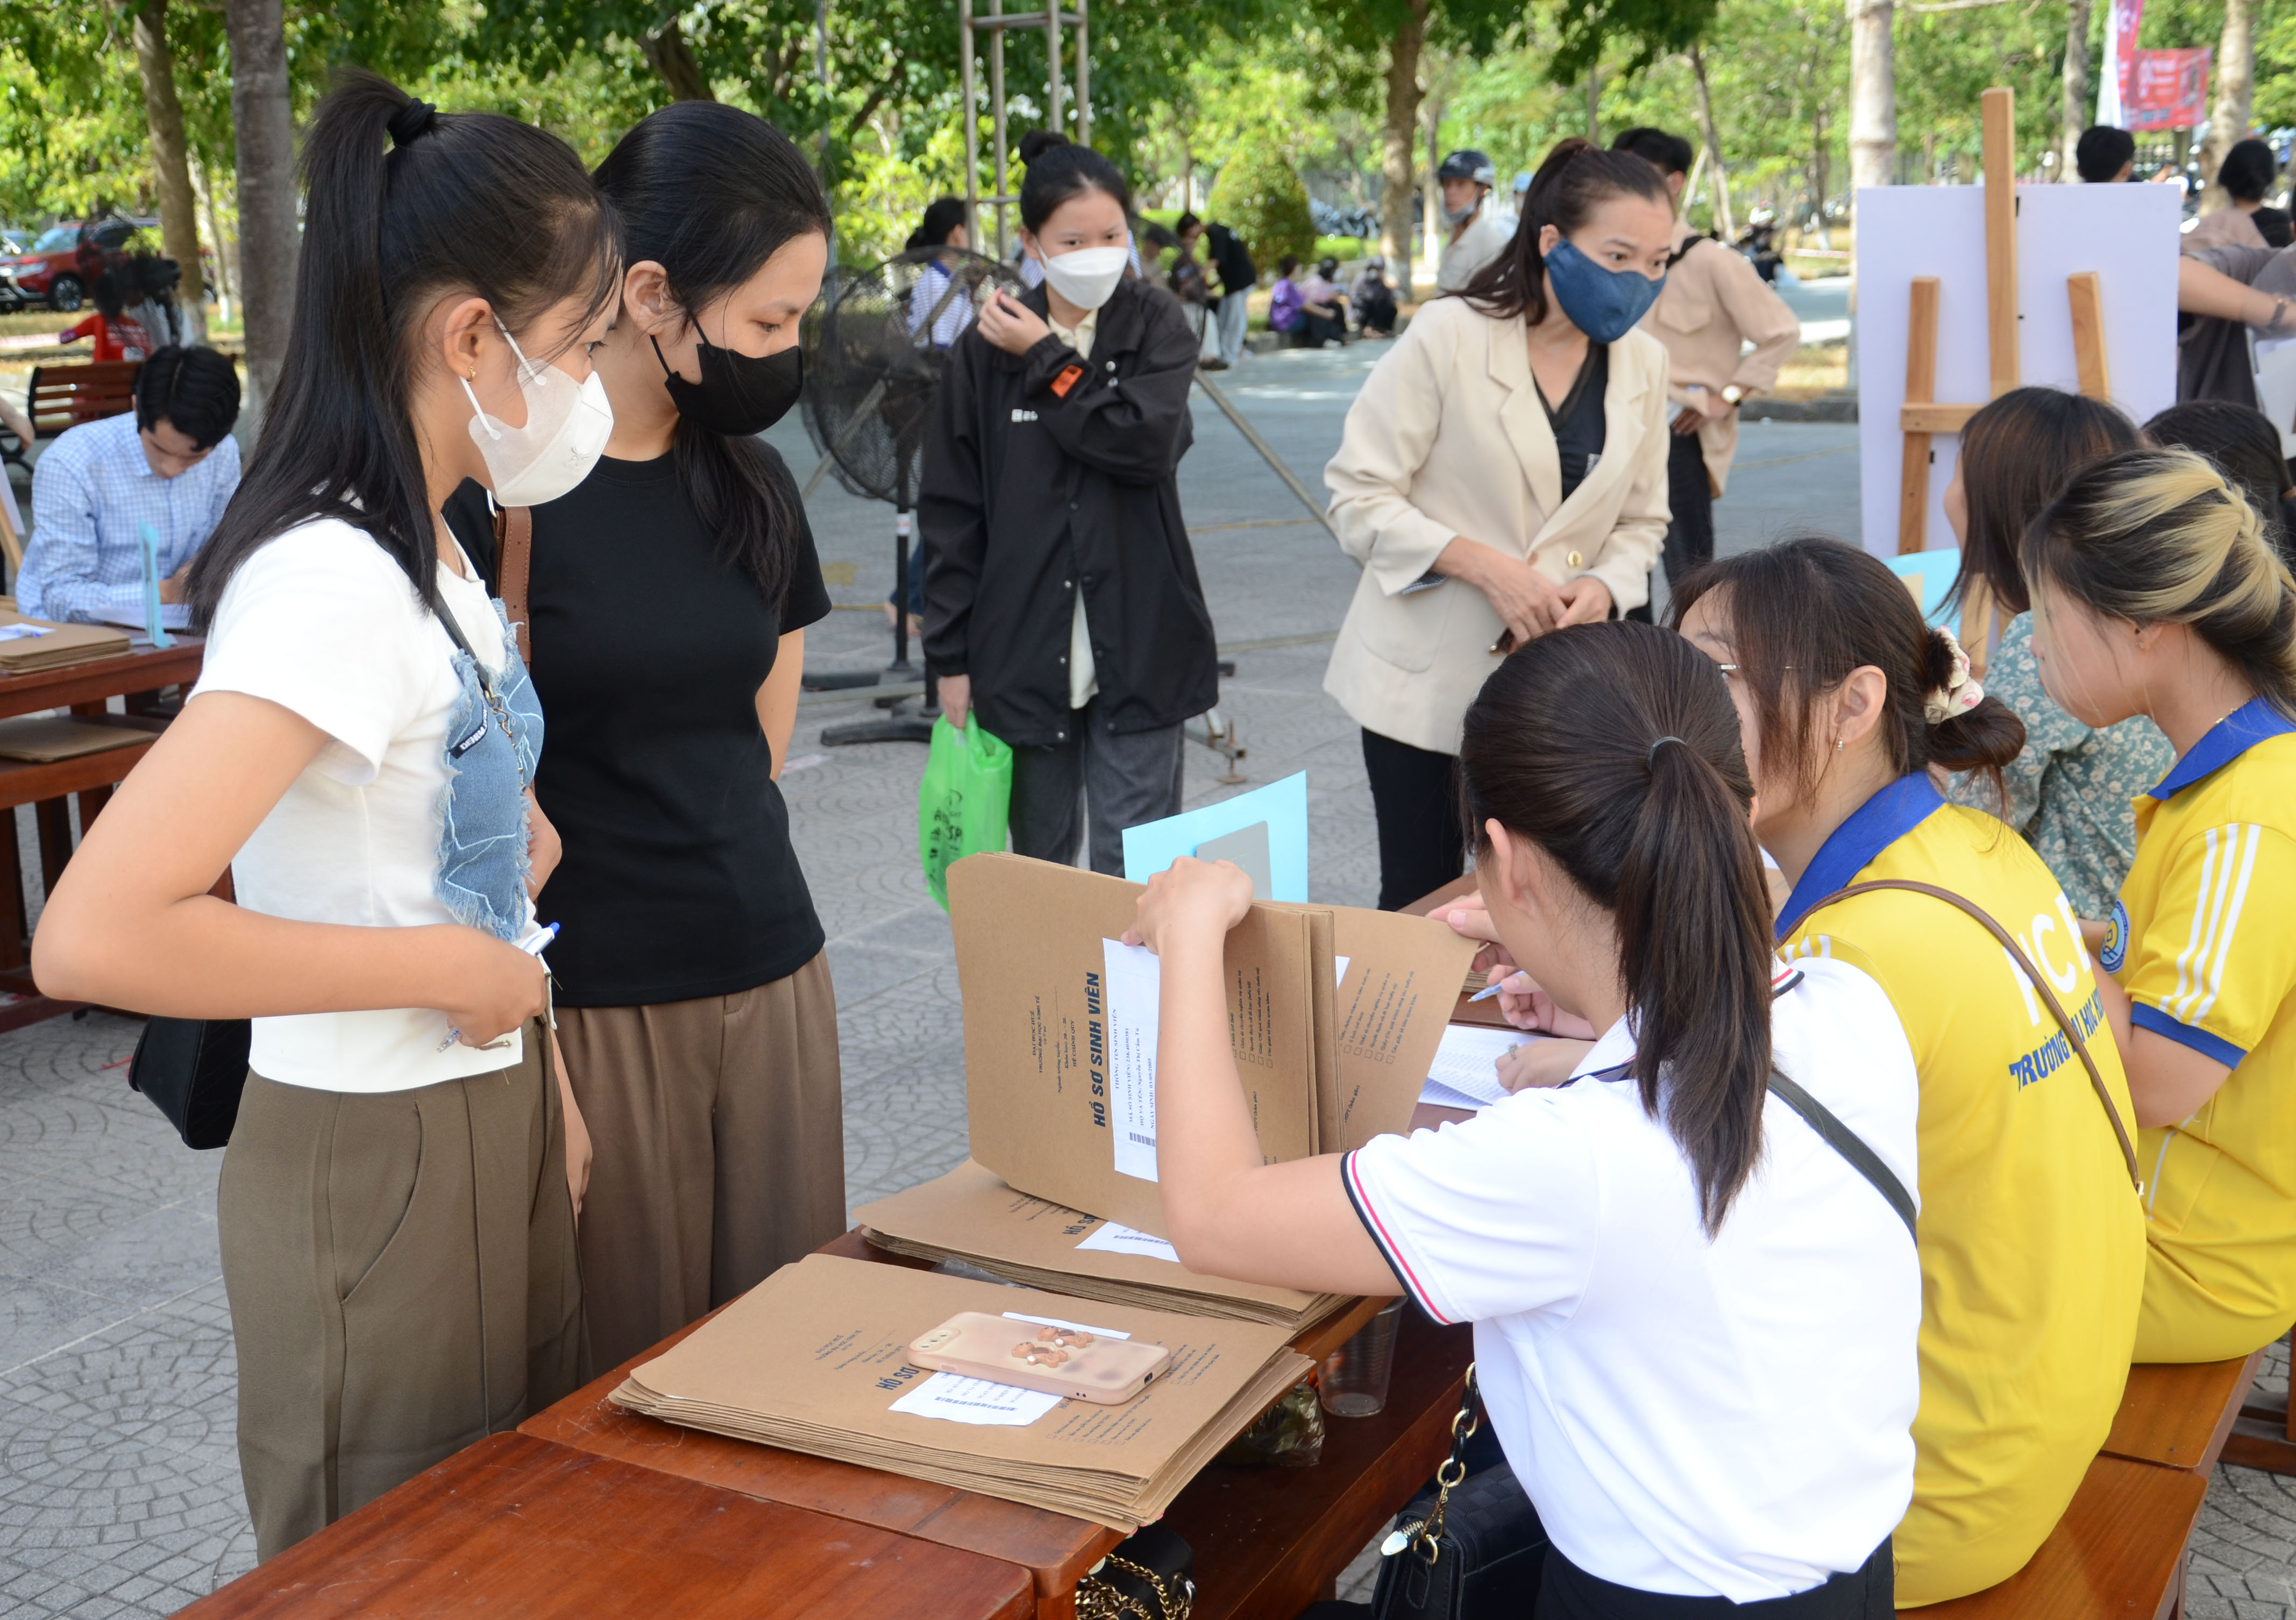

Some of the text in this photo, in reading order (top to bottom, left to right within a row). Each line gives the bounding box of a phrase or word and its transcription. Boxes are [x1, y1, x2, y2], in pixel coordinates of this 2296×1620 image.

[1085, 972, 1106, 1127] HỒ SƠ SINH VIÊN
[2009, 1028, 2071, 1092] TRƯỜNG
[875, 1367, 920, 1390] HỒ SƠ
